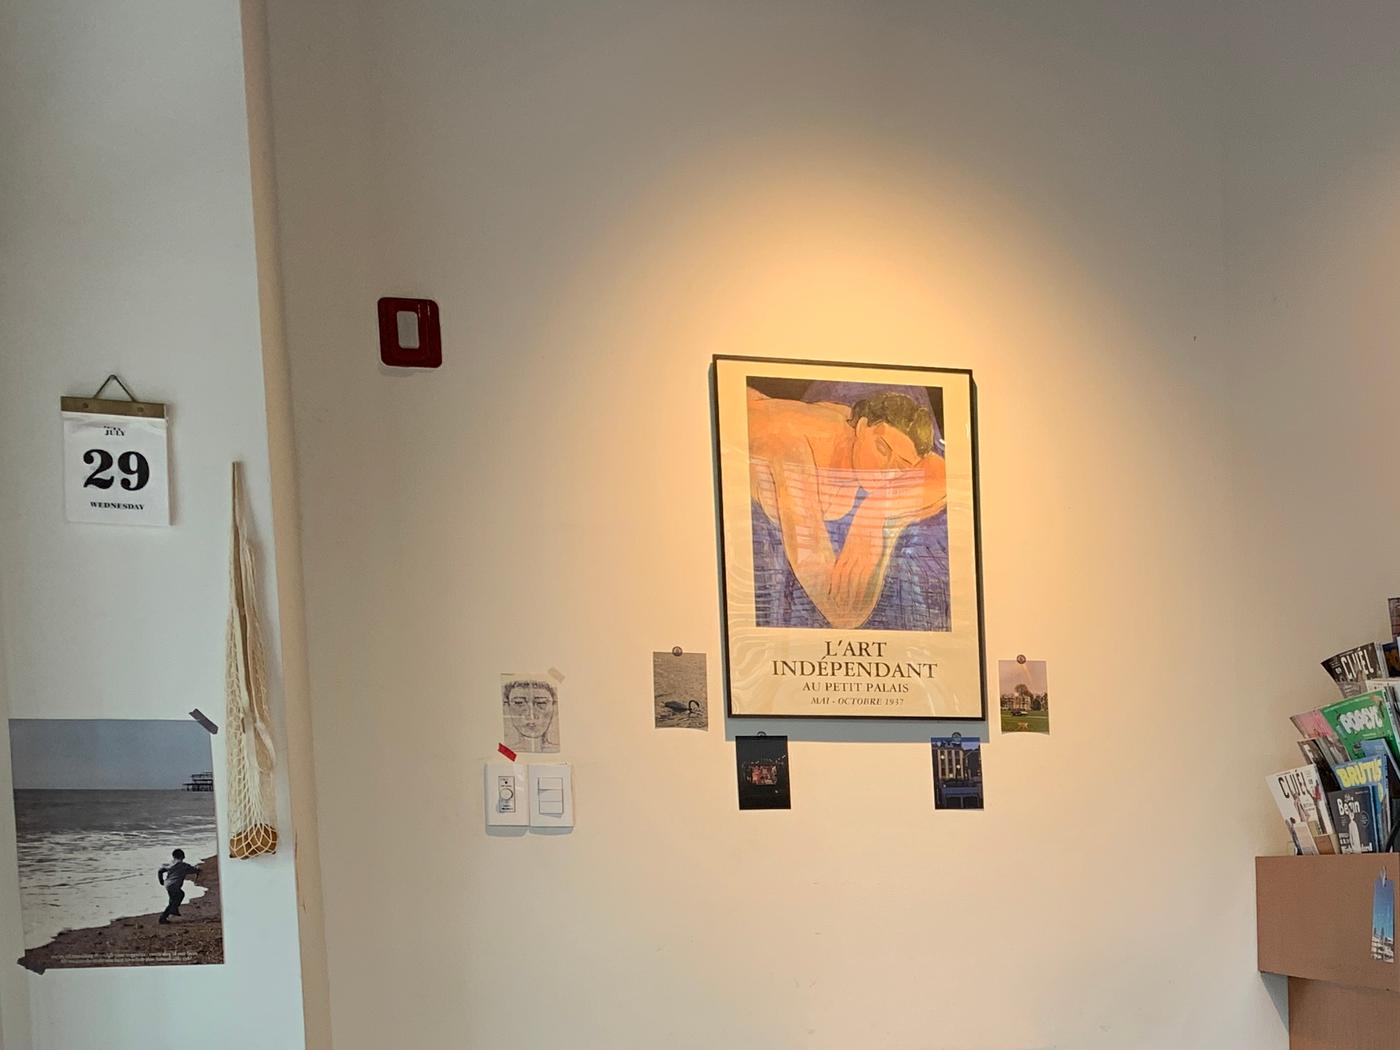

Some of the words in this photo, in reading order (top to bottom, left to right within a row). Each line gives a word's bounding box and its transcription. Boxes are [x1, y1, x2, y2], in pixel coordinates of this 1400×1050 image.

[83, 449, 150, 491] 29
[90, 501, 145, 510] WEDNESDAY
[825, 640, 887, 657] L'ART
[772, 656, 938, 679] INDÉPENDANT
[802, 682, 821, 692] AU
[825, 682, 862, 692] PETIT
[866, 683, 909, 693] PALAIS
[811, 697, 830, 705] MAI
[838, 697, 882, 706] OCTOBRE
[884, 698, 904, 706] 1937
